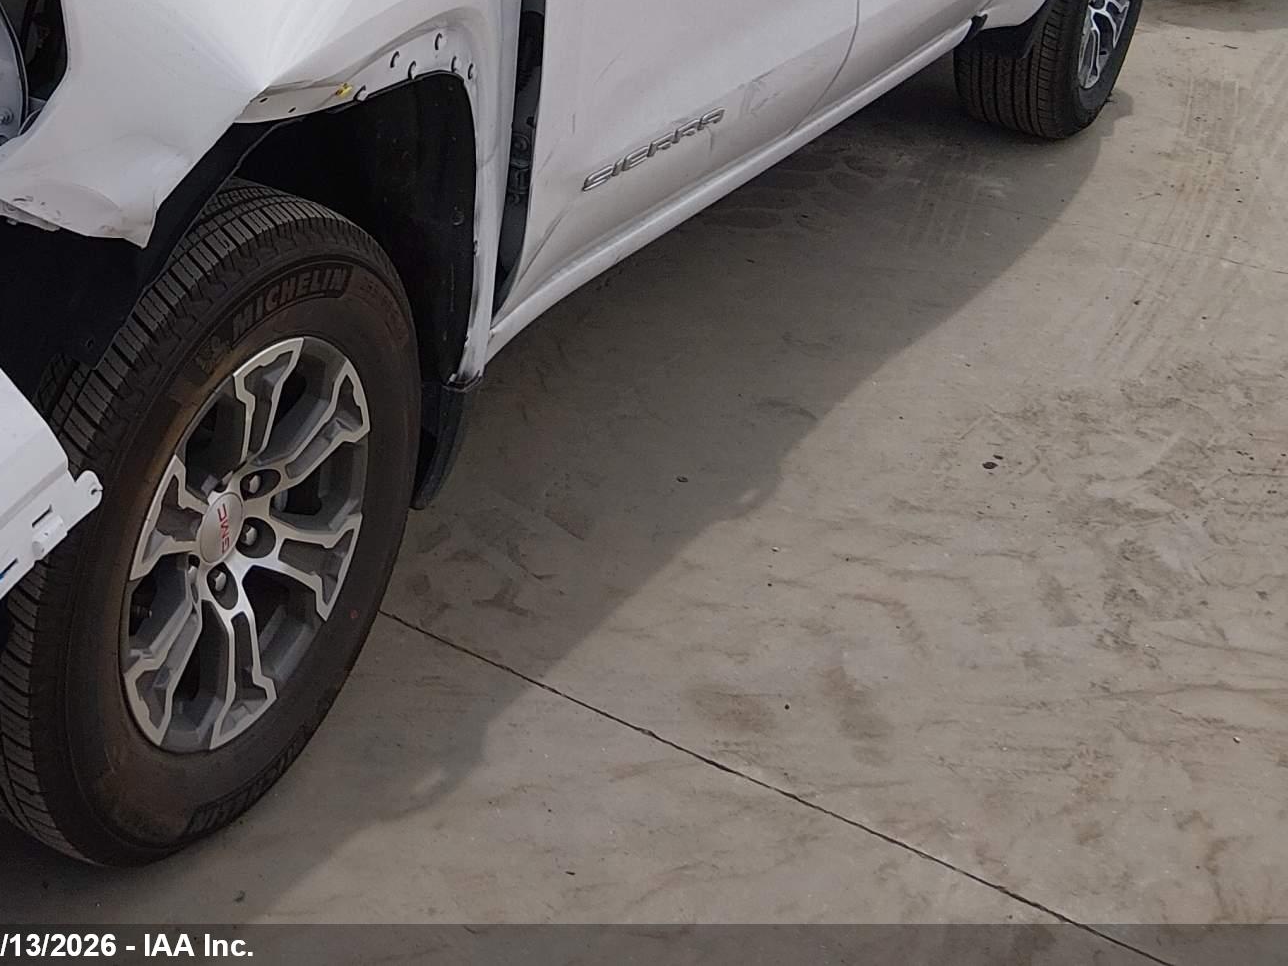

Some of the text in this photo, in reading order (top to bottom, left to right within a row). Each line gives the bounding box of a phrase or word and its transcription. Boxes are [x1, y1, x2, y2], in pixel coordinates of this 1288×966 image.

[581, 106, 726, 192] SIERRA
[231, 266, 350, 342] MICHELIN
[216, 502, 231, 555] GMC
